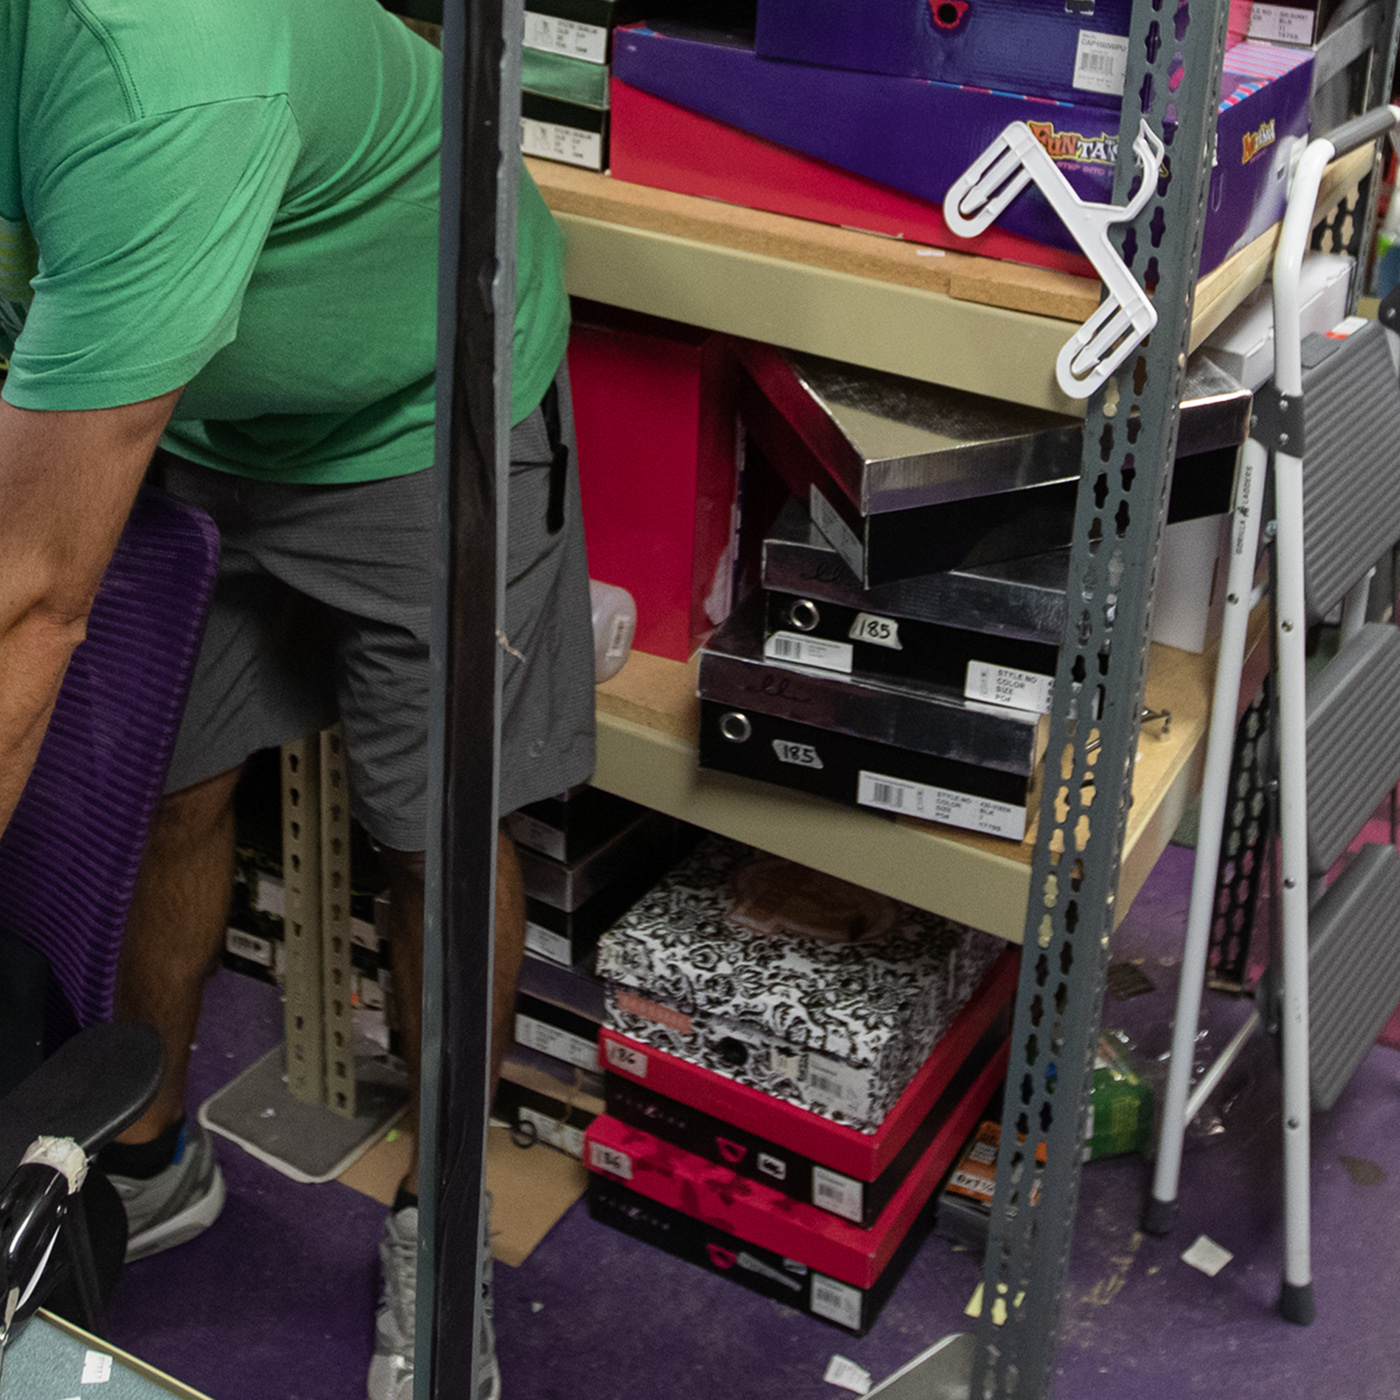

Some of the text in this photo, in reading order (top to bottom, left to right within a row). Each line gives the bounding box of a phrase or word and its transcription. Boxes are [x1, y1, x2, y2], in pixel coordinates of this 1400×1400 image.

[1242, 465, 1254, 505] LADDERS
[860, 619, 890, 639] 185
[996, 677, 1026, 690] COLOR
[997, 669, 1037, 684] STYLE NO
[996, 685, 1013, 695] SIZE
[783, 745, 815, 763] 185
